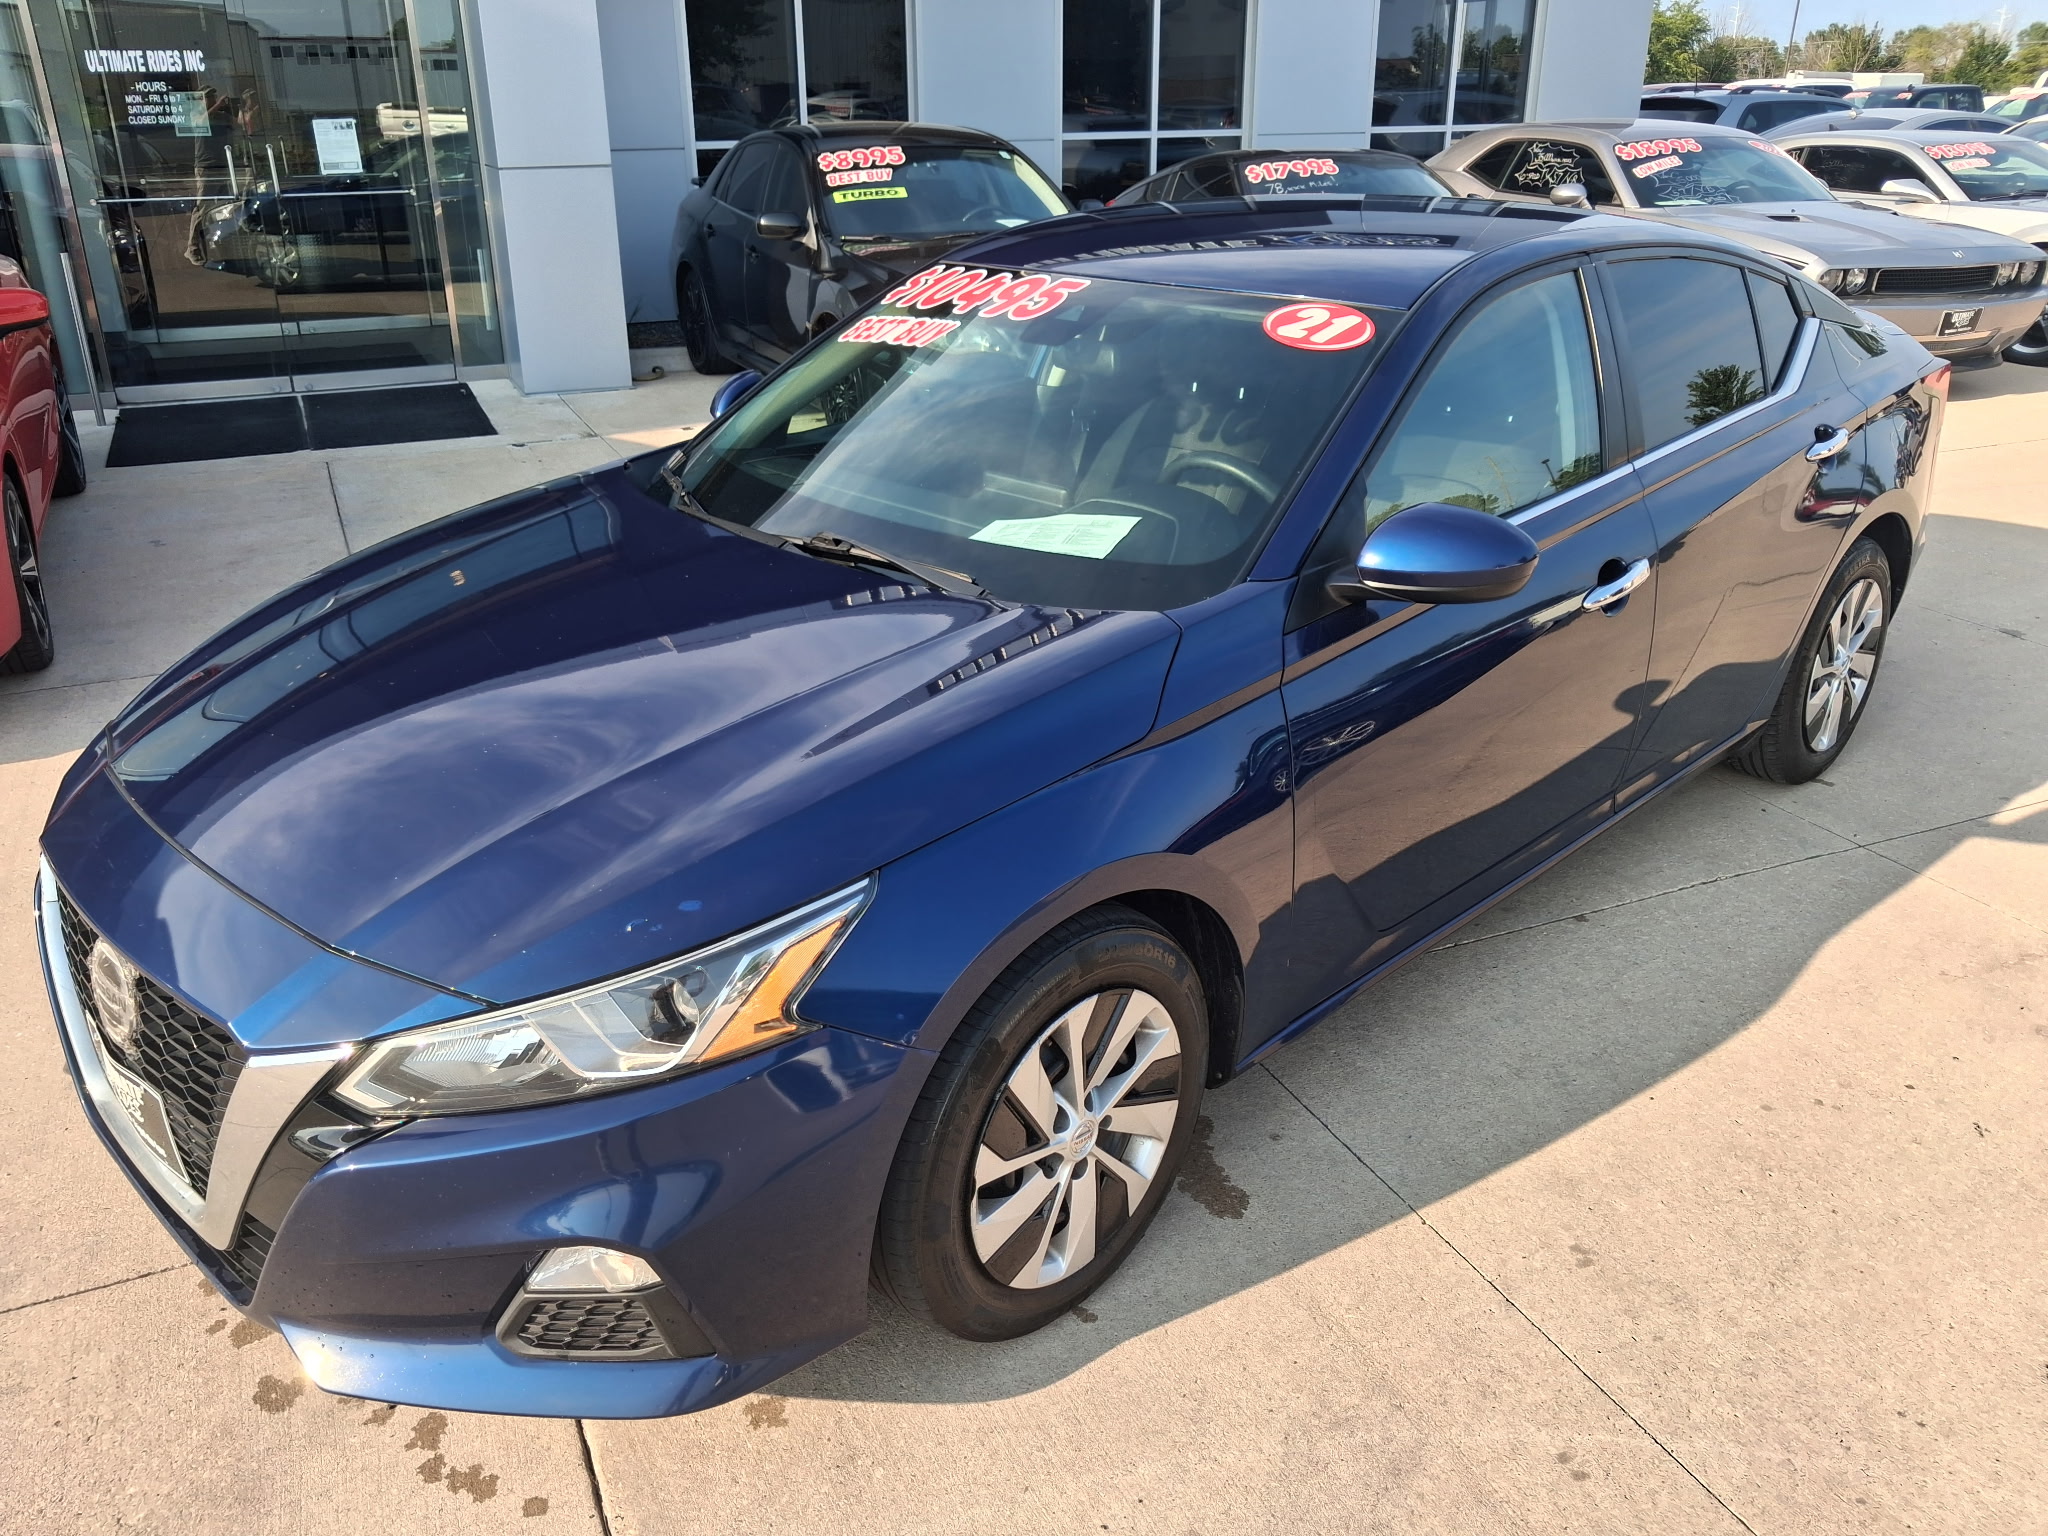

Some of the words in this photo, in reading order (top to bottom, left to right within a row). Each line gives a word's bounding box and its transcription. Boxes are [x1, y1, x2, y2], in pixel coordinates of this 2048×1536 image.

[83, 49, 146, 72] ULTIMATE
[146, 49, 182, 72] RIDES
[183, 49, 206, 72] INC
[135, 82, 167, 92] HOURS
[125, 94, 144, 103] MON.
[149, 94, 163, 103] FRI.
[163, 94, 168, 103] 9
[169, 94, 176, 103] to
[176, 94, 180, 102] 7
[128, 104, 164, 113] SATURDAY
[165, 105, 170, 113] 9
[171, 105, 177, 113] to
[178, 104, 183, 113] 4
[128, 115, 157, 124] CLOSED
[158, 115, 186, 124] SUNDAY
[817, 146, 906, 172] $8995
[1614, 138, 1702, 161] $18995
[827, 172, 861, 187] BEST
[866, 169, 892, 183] BUY
[1245, 158, 1339, 183] $17995
[1634, 162, 1655, 178] LOW
[1655, 156, 1683, 173] MILES
[839, 189, 899, 201] TURBO
[881, 264, 1092, 321] $10495
[840, 317, 902, 343] BEST
[897, 319, 961, 347] BUY
[1276, 308, 1363, 344] 21
